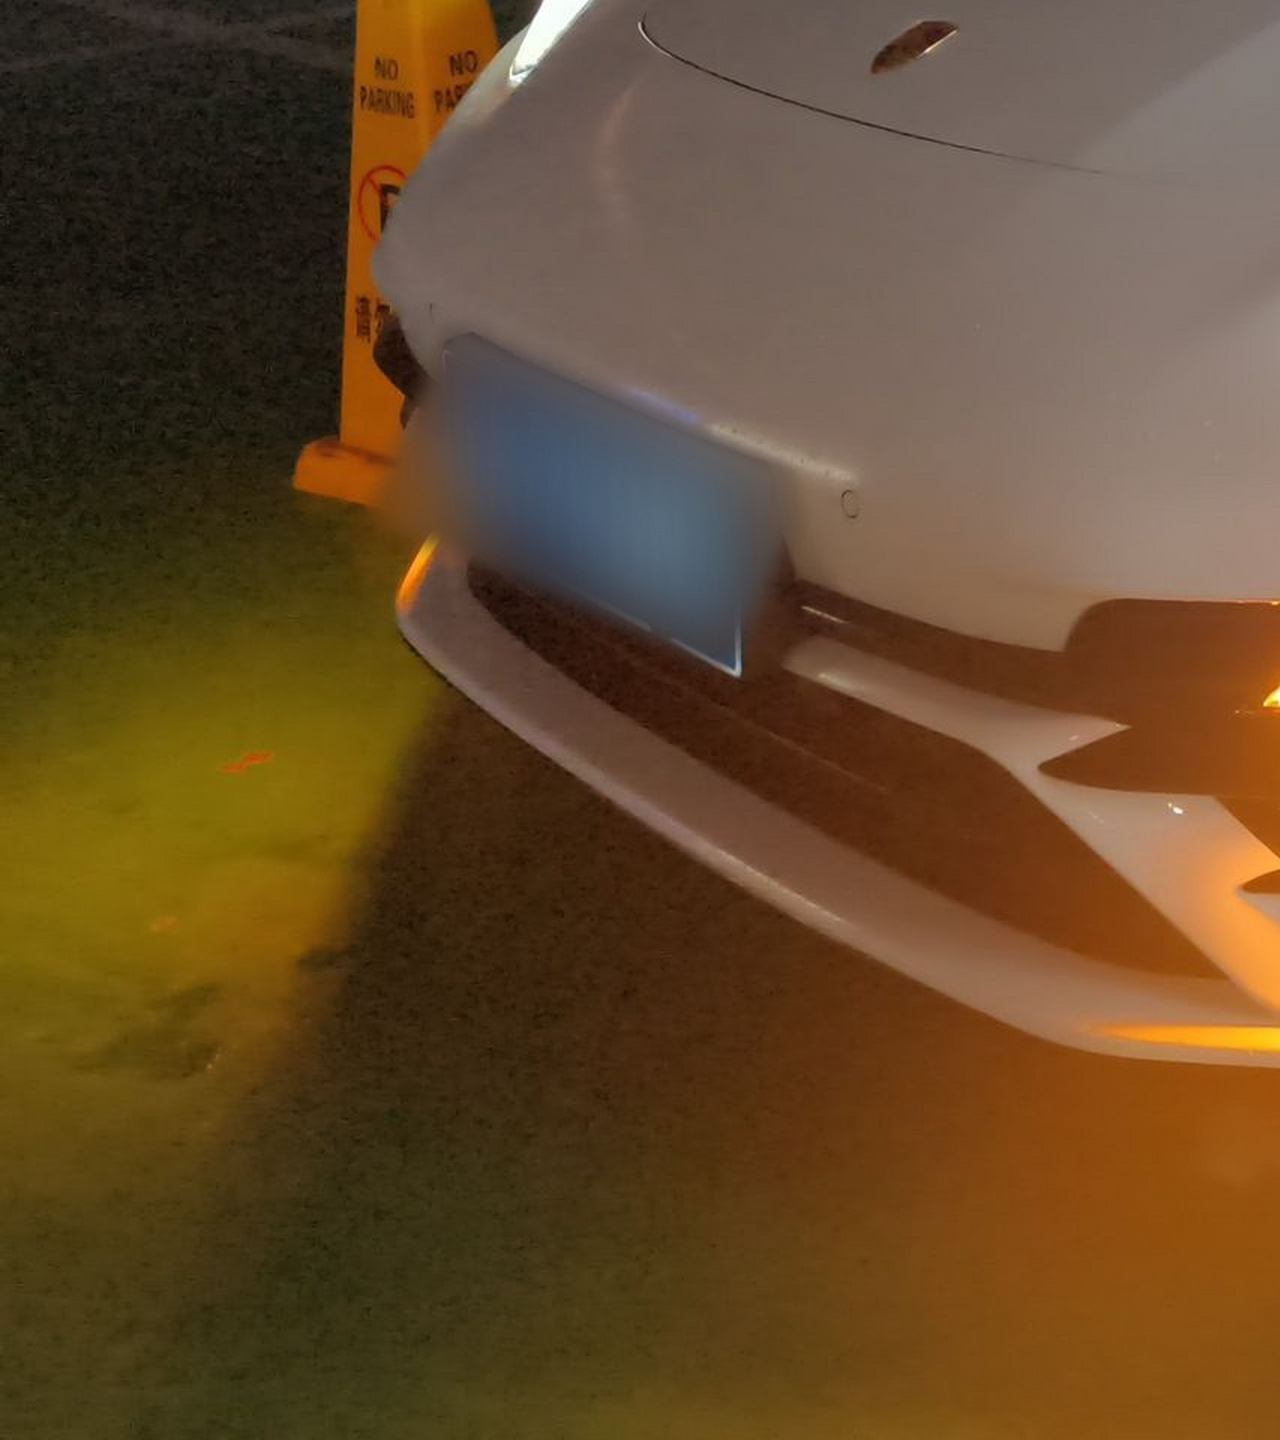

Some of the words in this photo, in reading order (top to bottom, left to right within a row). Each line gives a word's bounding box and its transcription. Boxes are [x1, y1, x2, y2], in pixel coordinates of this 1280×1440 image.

[374, 56, 399, 81] NO
[449, 50, 478, 77] NO
[360, 85, 415, 119] PARKING
[434, 81, 473, 113] PAR
